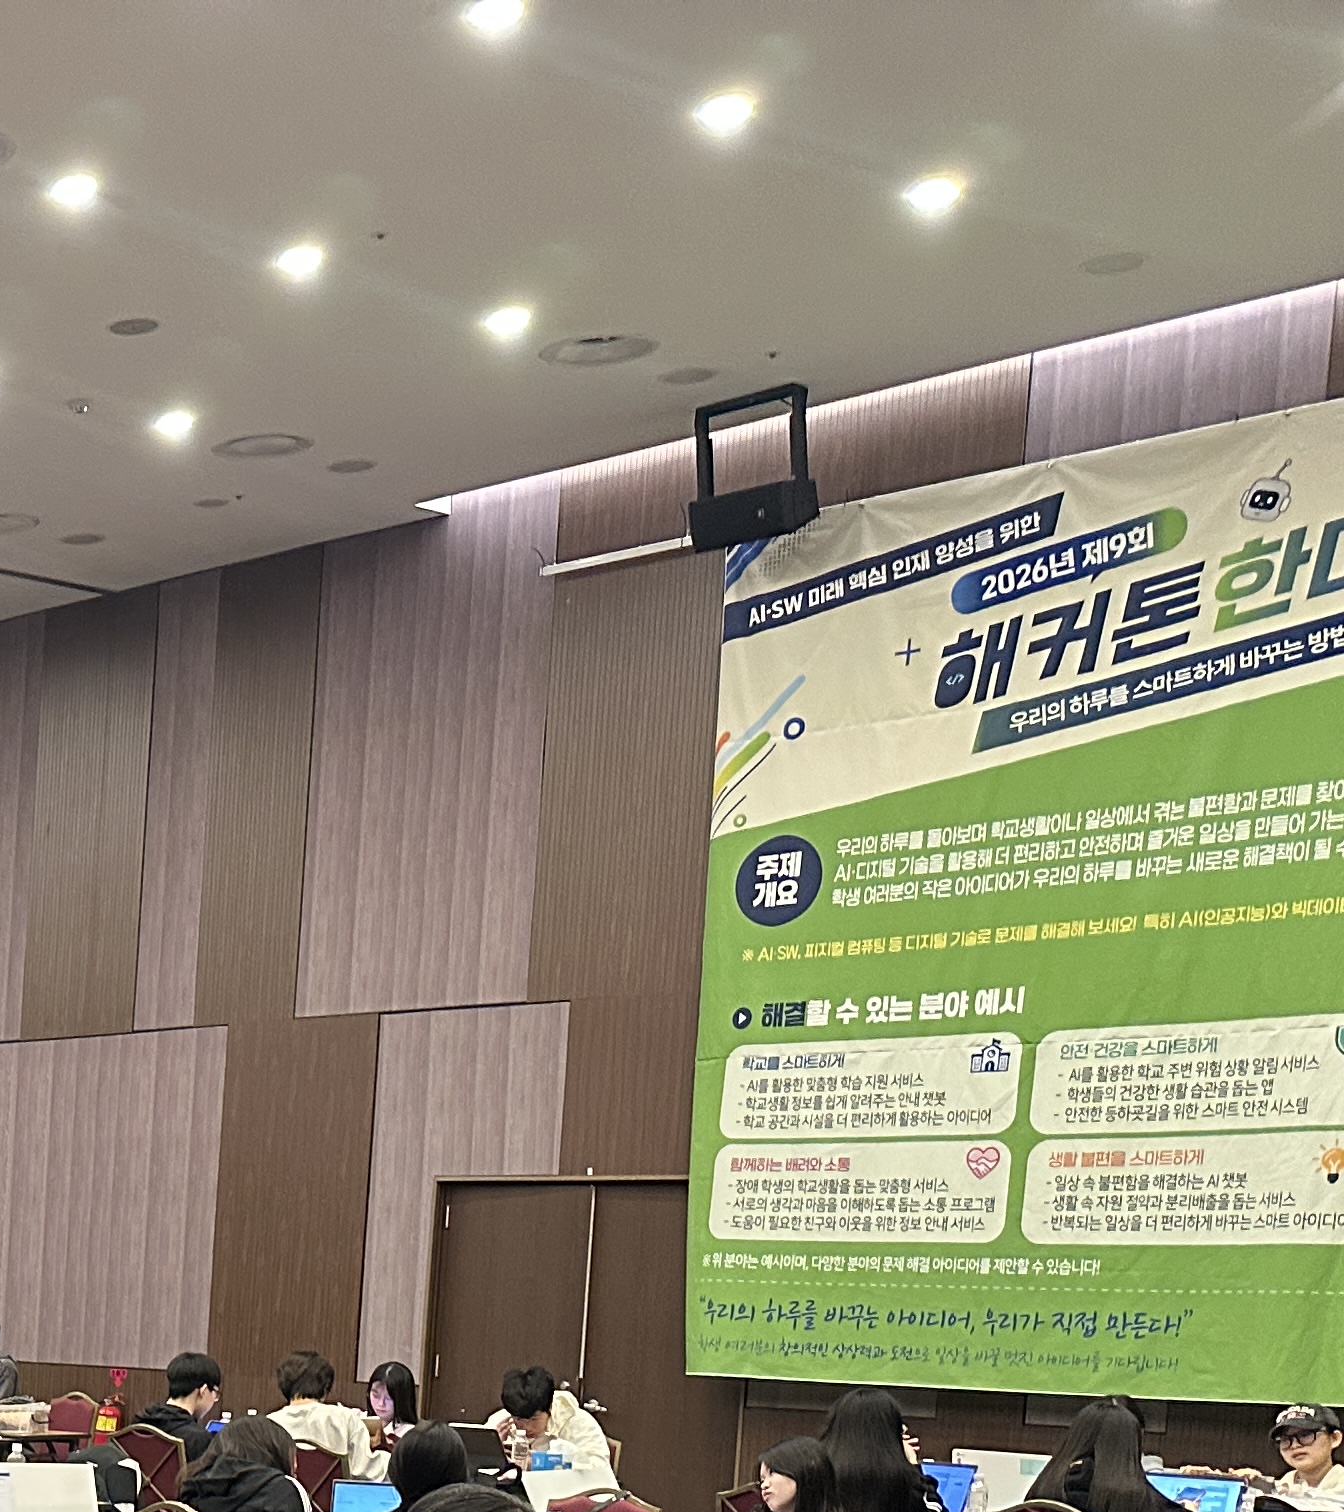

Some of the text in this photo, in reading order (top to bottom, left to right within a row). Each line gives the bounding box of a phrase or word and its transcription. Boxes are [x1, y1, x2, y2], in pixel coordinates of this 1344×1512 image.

[748, 512, 1041, 628] AI·SW 미래 핵심 인재 양성을 위한
[981, 522, 1154, 601] 2026년 제9회
[1009, 698, 1066, 733] 우리의
[1069, 684, 1129, 716] 하루를
[1132, 654, 1235, 701] 스마트하게
[1239, 638, 1304, 670] 바꾸는
[836, 836, 878, 858] 우리의
[880, 829, 924, 852] 하루를
[927, 822, 986, 849] 돌아보며
[991, 811, 1082, 840] 학교생활이나
[1085, 802, 1150, 831] 일상에서
[1154, 801, 1185, 822] 겪는
[1188, 789, 1258, 818] 불편함과
[1261, 783, 1313, 810] 문제를
[898, 853, 944, 876] 기술을
[948, 847, 992, 872] 활용해
[995, 846, 1010, 865] 더
[1014, 839, 1075, 864] 편리하고
[1079, 831, 1144, 858] 안전하며
[1147, 826, 1194, 852] 즐거운
[1199, 819, 1251, 845] 일상을
[1254, 812, 1306, 838] 만들어
[756, 851, 803, 880] 주제
[832, 836, 1332, 907] 학생 여러분의 작은 아이디어가 우리의 하루를 바꾸는 새로운 해결책이 될
[752, 880, 799, 908] 개요
[761, 986, 1025, 1028] 해결할 수 있는 분야 예시
[746, 1073, 924, 1092] AI를 활용한 맞춤형 학습 지원 서비스
[746, 1091, 946, 1111] 학교생활 정보를 쉽게 알려주는 안내 챗봇
[744, 1108, 991, 1129] 학교 공간과 시설을 더 편리하게 활용하는 아이디어
[724, 1254, 759, 1269] 분야는
[761, 1255, 808, 1271] 예시이며,
[812, 1256, 845, 1272] 다양한
[847, 1256, 880, 1272] 분야의
[883, 1257, 904, 1273] 문제
[907, 1257, 929, 1273] 해결
[933, 1257, 991, 1275] 아이디어를
[993, 1258, 1029, 1275] 제안할
[1032, 1259, 1044, 1275] 수
[1047, 1259, 1101, 1276] 있습니다!
[762, 1298, 818, 1331] 하루를
[823, 1304, 879, 1330] 바꾸는
[886, 1309, 975, 1335] 아이디어,
[983, 1308, 1045, 1337] 우리가
[1052, 1310, 1098, 1338] 직접
